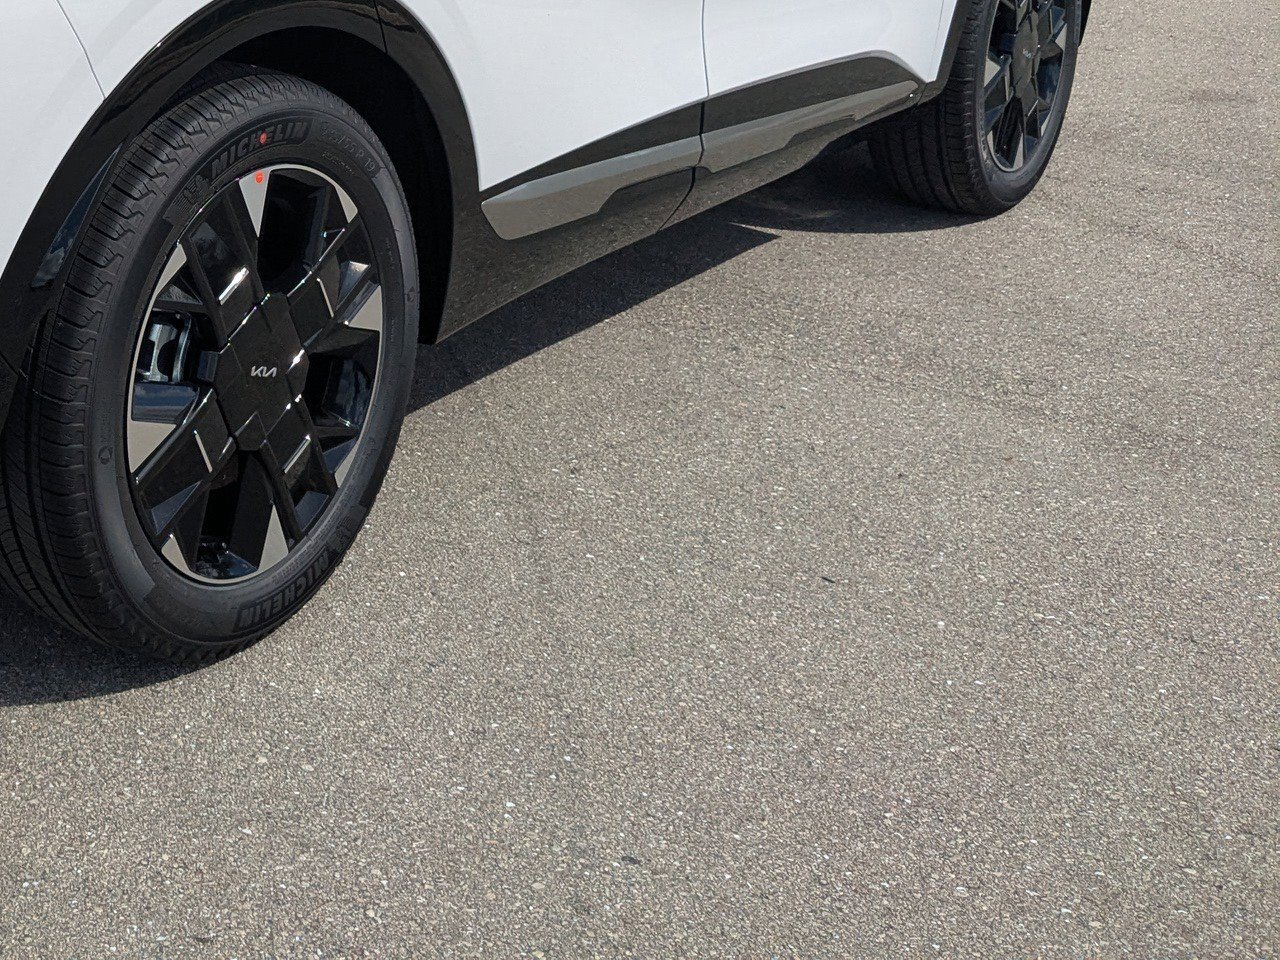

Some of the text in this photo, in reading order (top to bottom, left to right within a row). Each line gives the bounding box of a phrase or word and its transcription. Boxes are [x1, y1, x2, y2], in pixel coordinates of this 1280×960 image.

[211, 122, 308, 179] MICHELIN
[250, 365, 278, 378] KIA
[239, 548, 329, 628] MICHELIN
